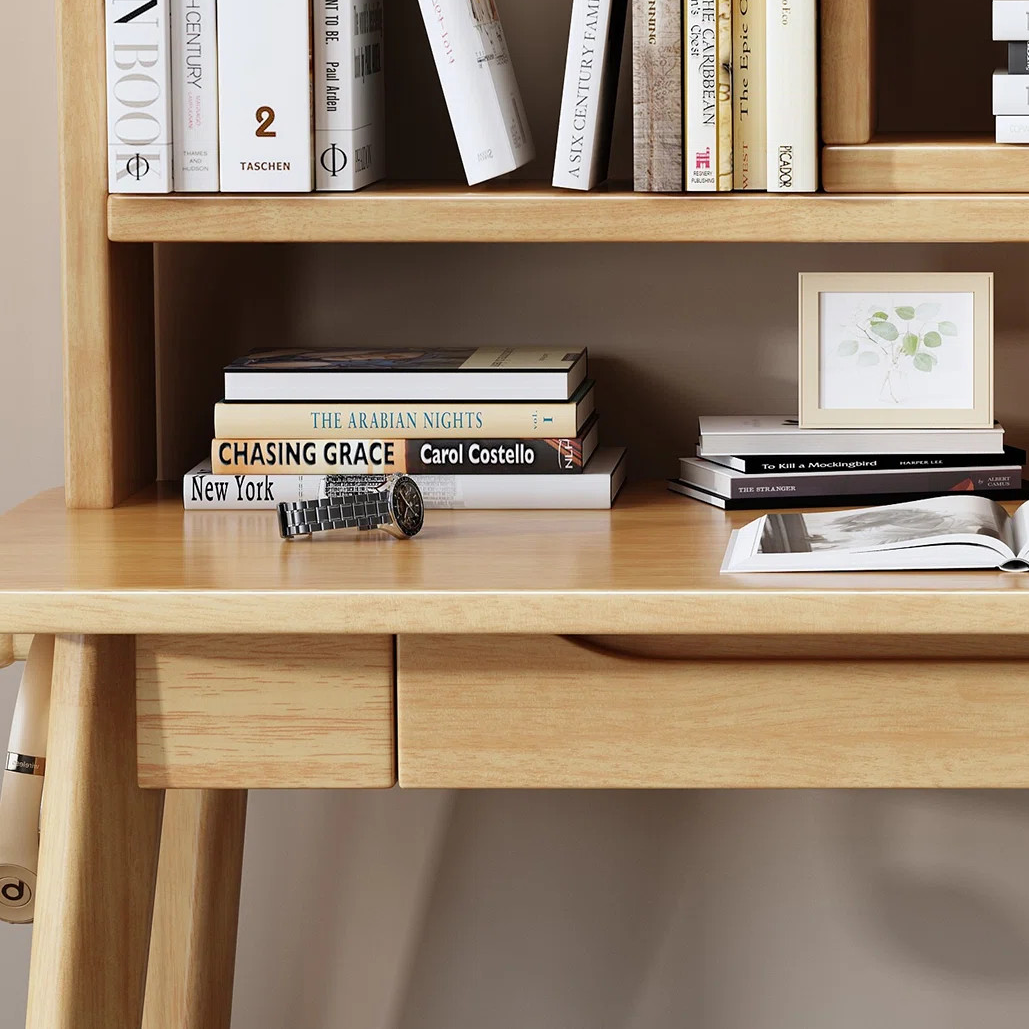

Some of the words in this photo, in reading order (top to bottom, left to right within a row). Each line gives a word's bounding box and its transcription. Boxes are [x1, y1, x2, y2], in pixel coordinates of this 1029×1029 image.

[325, 13, 339, 26] TO
[185, 12, 202, 89] CENTURY
[325, 30, 340, 46] BE.
[690, 24, 701, 57] Chest
[739, 23, 751, 70] Epic
[325, 61, 340, 82] Paul
[699, 28, 716, 126] CARIBBEAN
[326, 85, 340, 112] Arden
[573, 45, 595, 132] CENTURY
[739, 78, 749, 122] The
[113, 40, 161, 181] BOOK
[255, 105, 277, 138] 2
[569, 134, 584, 163] SIX
[240, 161, 291, 171] TASCHEN
[568, 167, 580, 178] A
[779, 145, 792, 188] PICADOR
[310, 411, 345, 429] THE
[347, 411, 419, 429] ARABIAN
[423, 411, 483, 430] NIGHTS
[218, 442, 324, 467] CHASING
[325, 442, 395, 466] GRACE
[420, 443, 463, 465] Carol
[468, 443, 535, 465] Costello
[808, 460, 878, 468] Mockingbird
[190, 475, 231, 502] New
[234, 475, 275, 502] York
[756, 485, 796, 493] STRANGER
